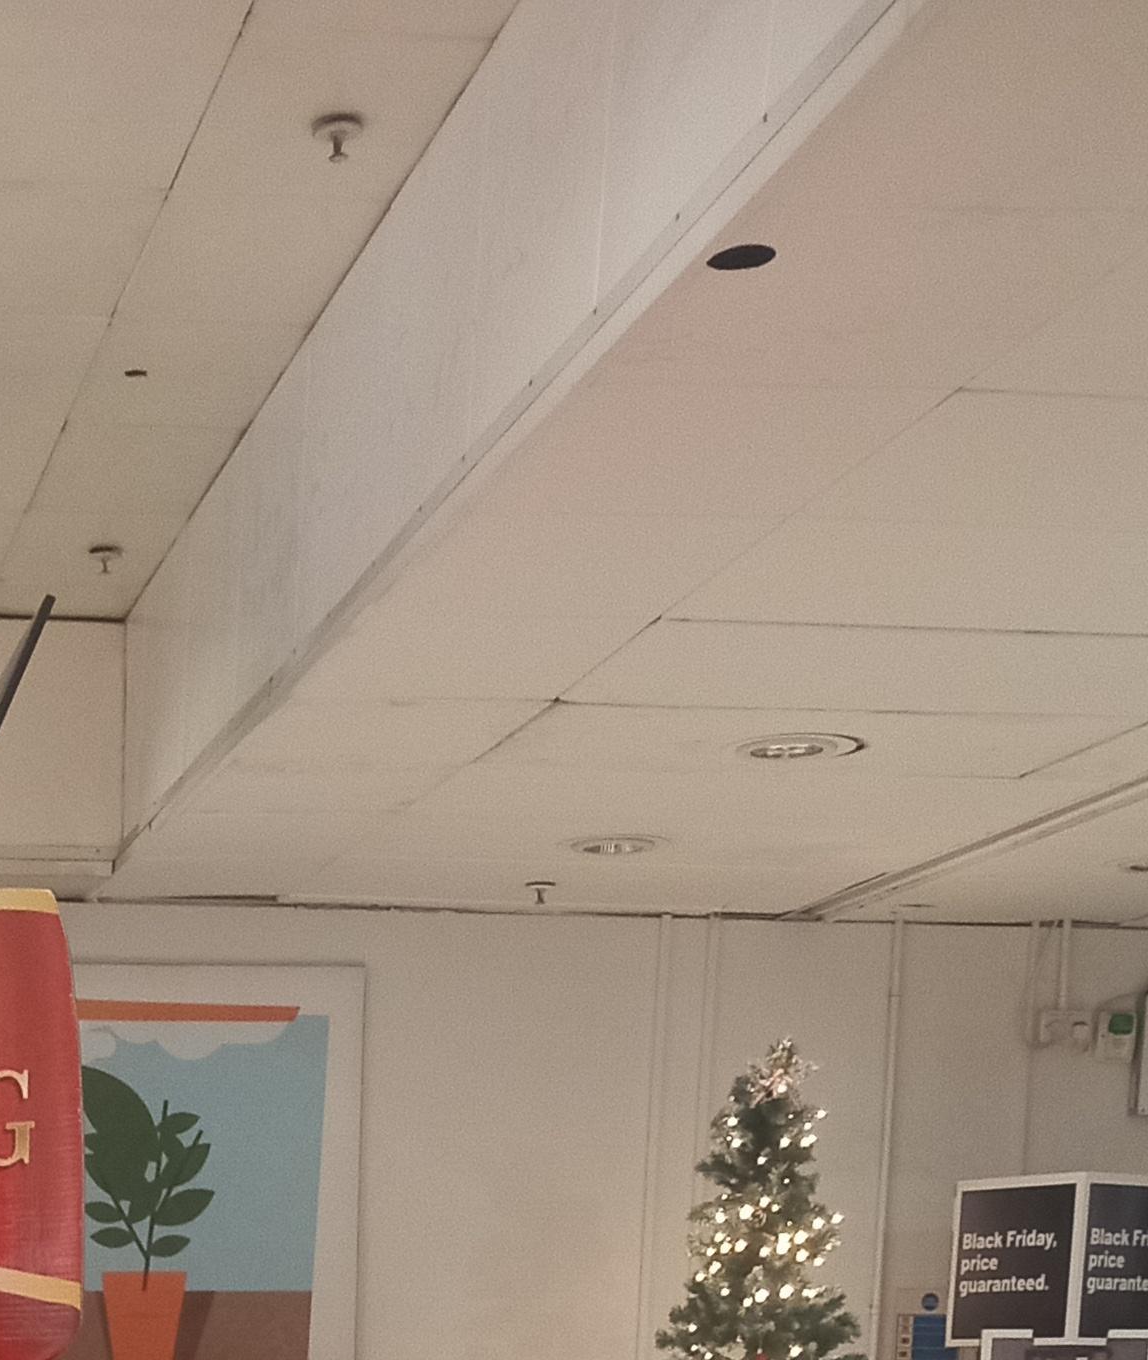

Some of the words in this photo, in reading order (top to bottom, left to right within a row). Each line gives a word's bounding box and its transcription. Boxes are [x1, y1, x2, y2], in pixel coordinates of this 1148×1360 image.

[962, 1231, 1003, 1250] Black
[1005, 1229, 1058, 1250] Friday,
[1090, 1228, 1129, 1247] Black
[960, 1255, 999, 1275] price
[1088, 1251, 1125, 1271] price
[958, 1274, 1050, 1297] guaranteed.
